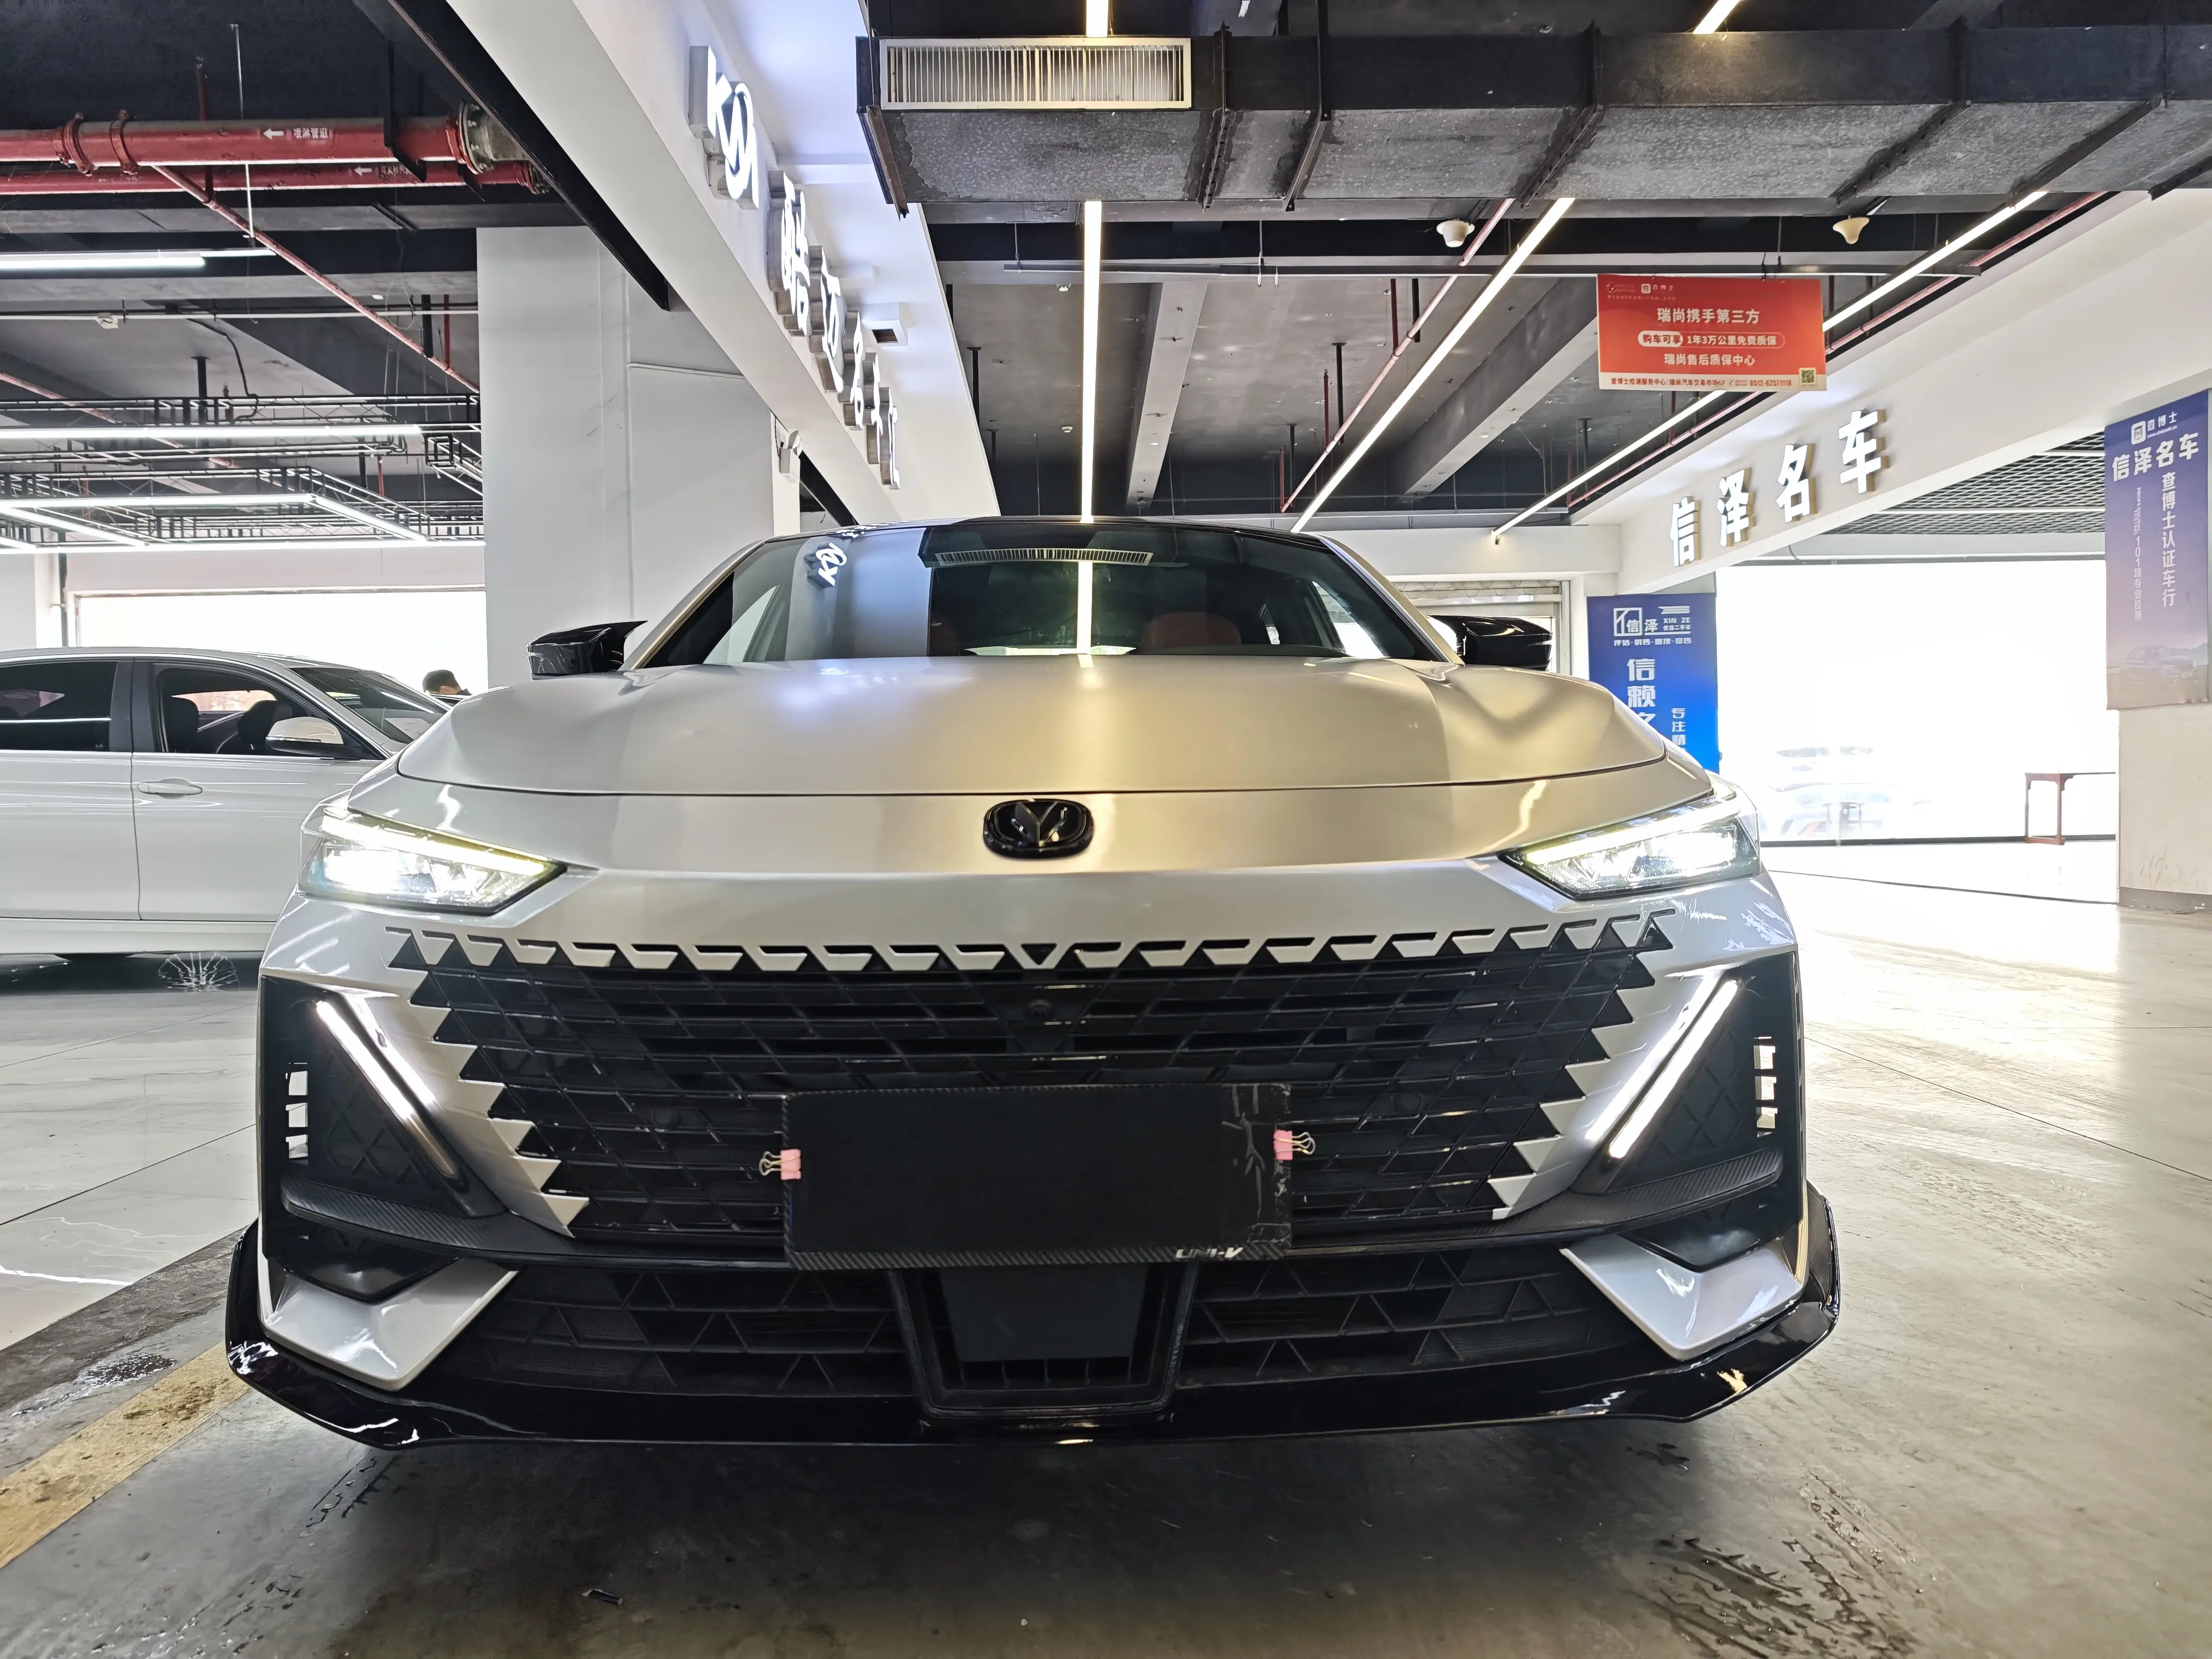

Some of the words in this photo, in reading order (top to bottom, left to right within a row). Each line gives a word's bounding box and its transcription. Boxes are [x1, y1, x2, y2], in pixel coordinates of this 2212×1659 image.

[1657, 307, 1760, 324] 瑞尚携手第三方
[1643, 334, 1681, 344] 购车可享
[1687, 335, 1777, 346] 1年3万公里免费质保
[1664, 353, 1755, 366] 瑞尚售后质保中心
[2147, 412, 2177, 431] 查博士
[2112, 432, 2200, 482] 信泽名车
[1669, 410, 1883, 567] 信泽名车
[2161, 471, 2176, 608] 查博士认证车行
[1626, 619, 1659, 632] 信泽
[1176, 1247, 1244, 1259] UNI-V
